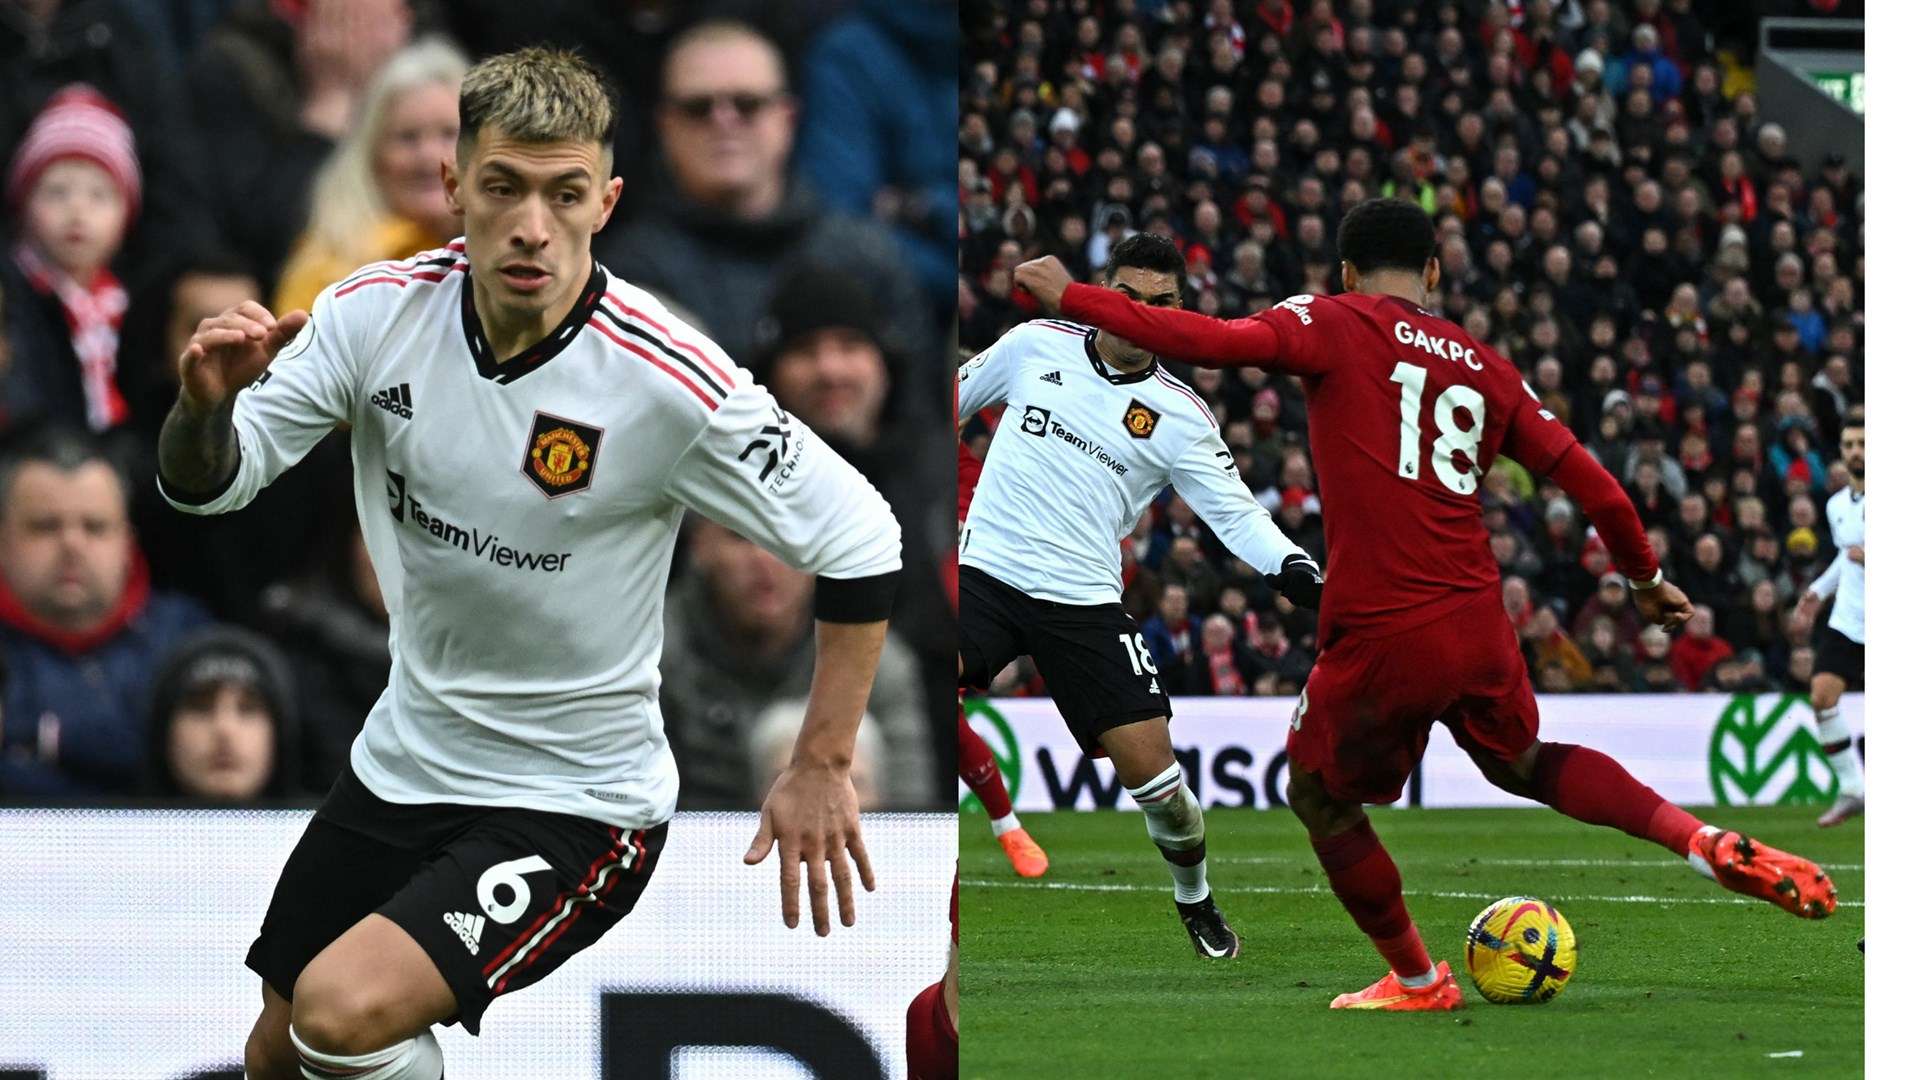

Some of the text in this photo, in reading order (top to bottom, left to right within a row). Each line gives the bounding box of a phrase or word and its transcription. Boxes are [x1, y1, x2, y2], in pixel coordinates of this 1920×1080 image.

[370, 394, 413, 420] adidas
[1389, 361, 1486, 495] 18
[540, 467, 573, 485] UNITED
[768, 430, 805, 494] TECHNO
[1050, 421, 1129, 477] TeamViewer
[407, 494, 572, 572] TeamViewer
[1119, 632, 1158, 676] 18
[476, 854, 553, 924] 6
[443, 912, 479, 956] adidas
